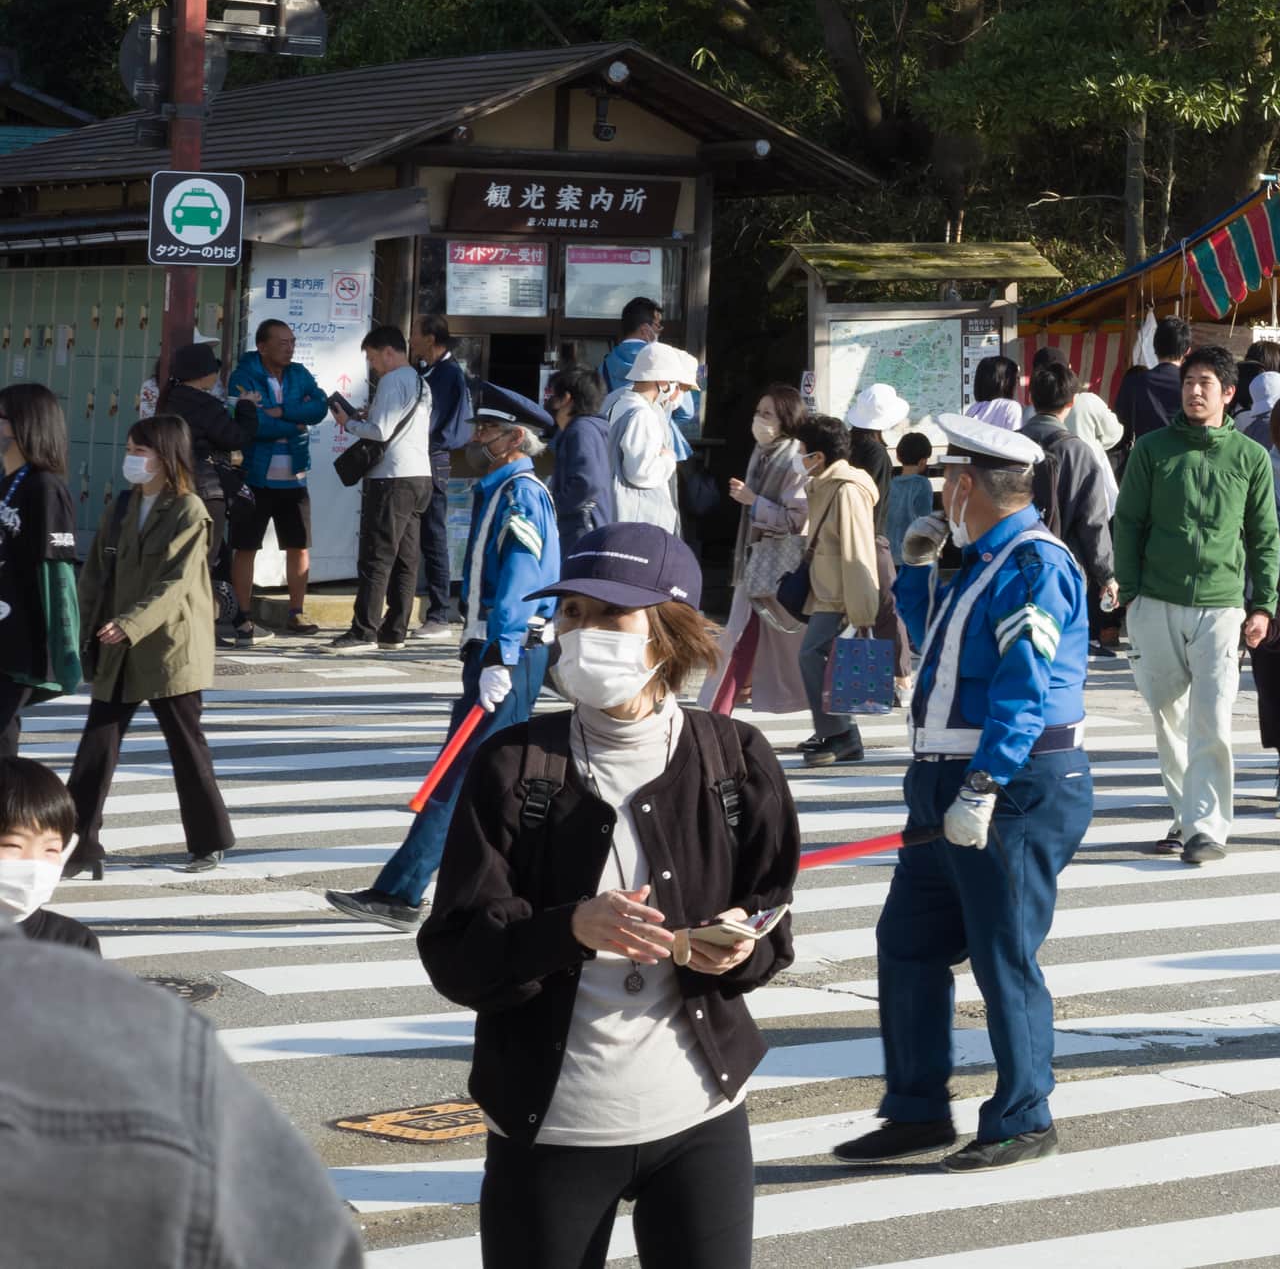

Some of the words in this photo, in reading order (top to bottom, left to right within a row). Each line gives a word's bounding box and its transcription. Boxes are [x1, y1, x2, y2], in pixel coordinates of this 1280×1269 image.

[483, 181, 647, 214] 観光案内所
[155, 244, 236, 258] タクシーのりば
[453, 245, 544, 263] ガイドツアー受付
[290, 278, 325, 290] 案内所
